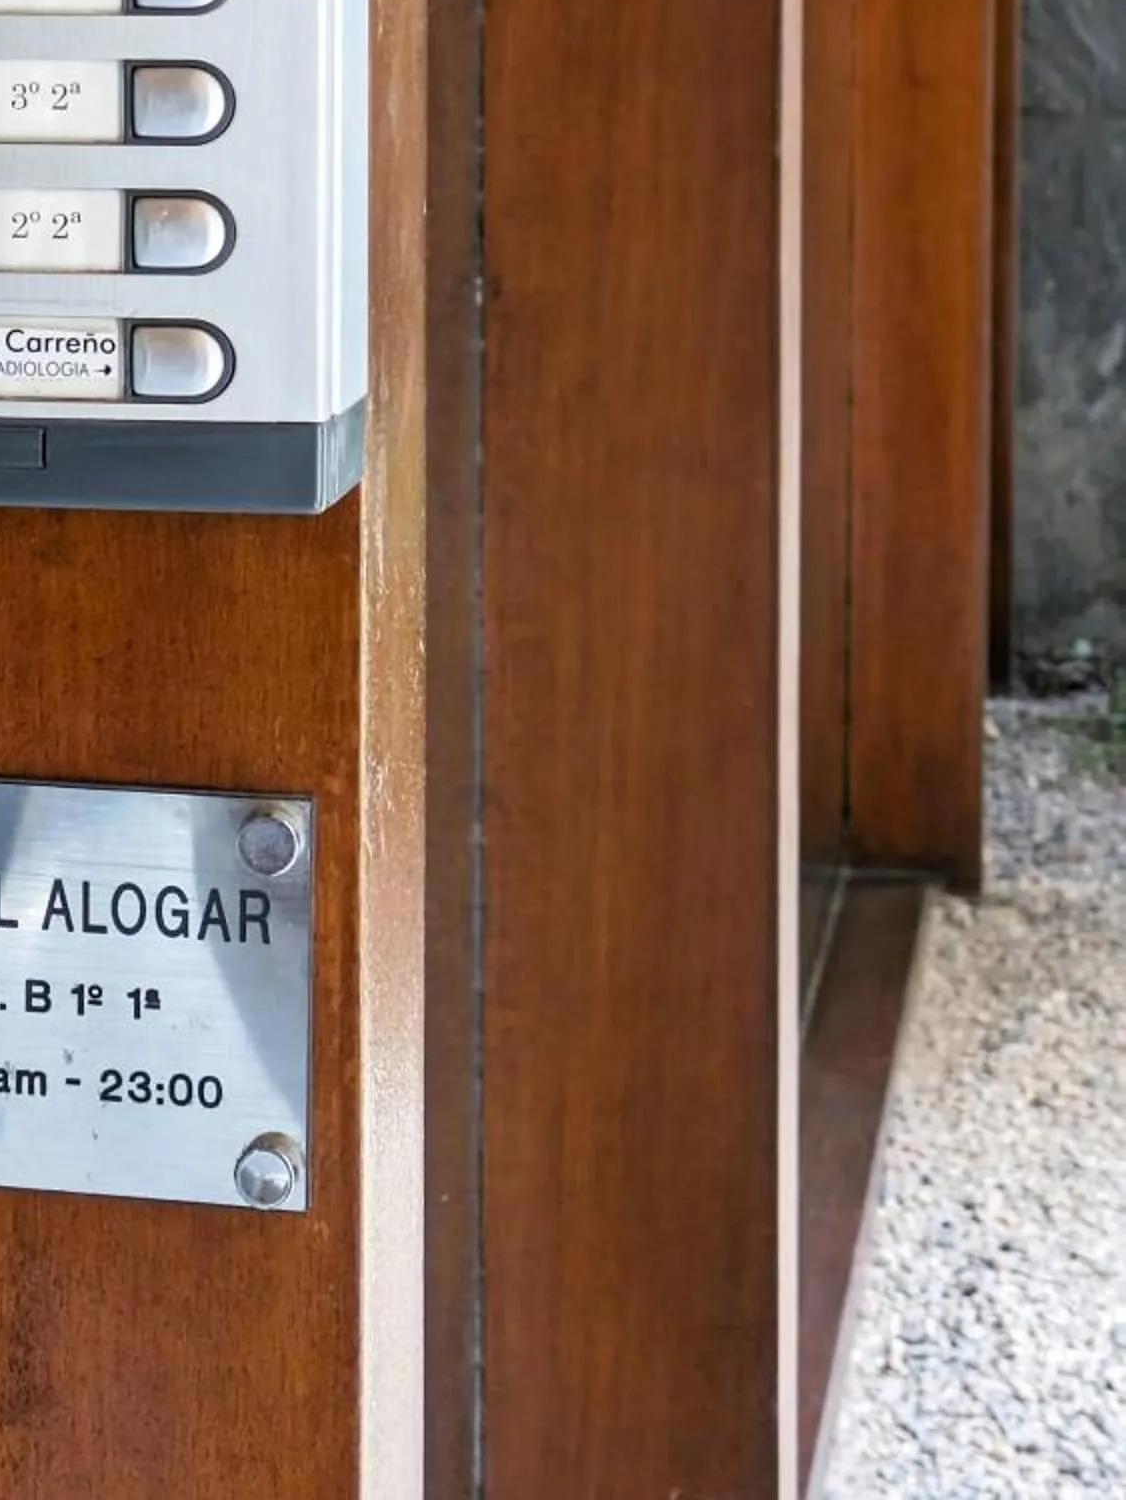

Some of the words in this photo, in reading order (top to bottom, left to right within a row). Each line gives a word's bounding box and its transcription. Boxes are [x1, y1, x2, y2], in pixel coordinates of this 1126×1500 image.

[5, 329, 116, 356] Carreño
[41, 877, 272, 945] ALOGAR
[24, 979, 53, 1014] B
[99, 1069, 224, 1109] 23:00
